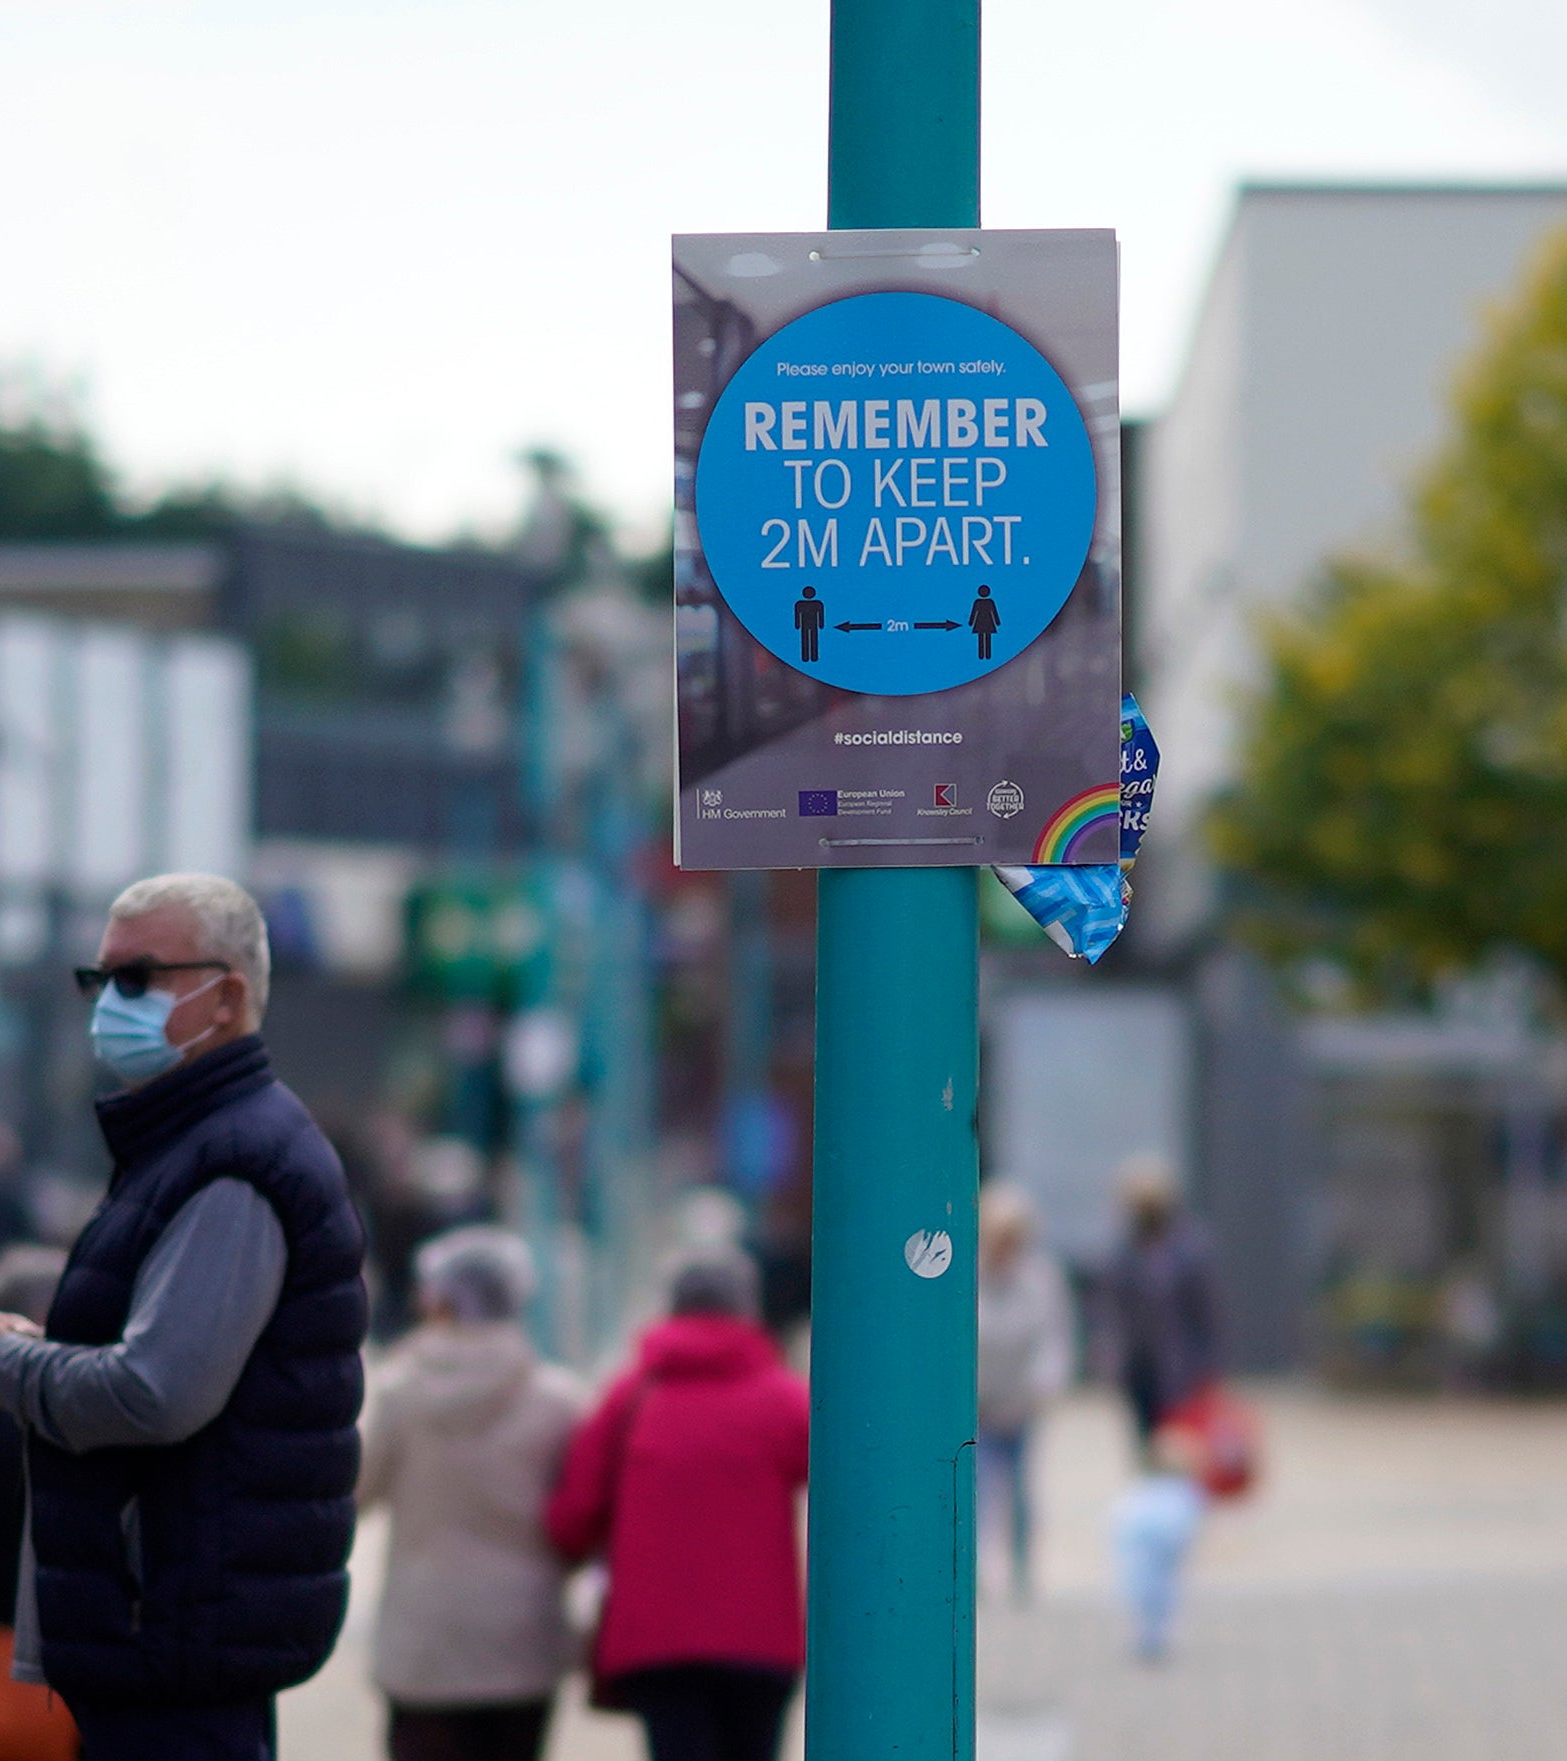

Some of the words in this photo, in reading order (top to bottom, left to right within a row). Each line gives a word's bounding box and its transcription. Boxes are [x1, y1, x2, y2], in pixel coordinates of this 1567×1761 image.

[777, 362, 827, 376] Please
[832, 361, 875, 377] enjoy
[879, 362, 914, 377] your
[917, 360, 955, 373] town
[959, 359, 1007, 376] safely.
[744, 398, 1049, 451] REMEMBER
[784, 458, 852, 509] TO
[874, 456, 1008, 508] KEEP
[760, 517, 839, 568] 2M
[859, 515, 1031, 567] APART.
[887, 618, 909, 632] 2m
[834, 730, 963, 745] #socialdistance
[837, 790, 878, 799] European
[879, 789, 906, 798] Union
[702, 809, 721, 819] HM
[724, 808, 787, 819] Government
